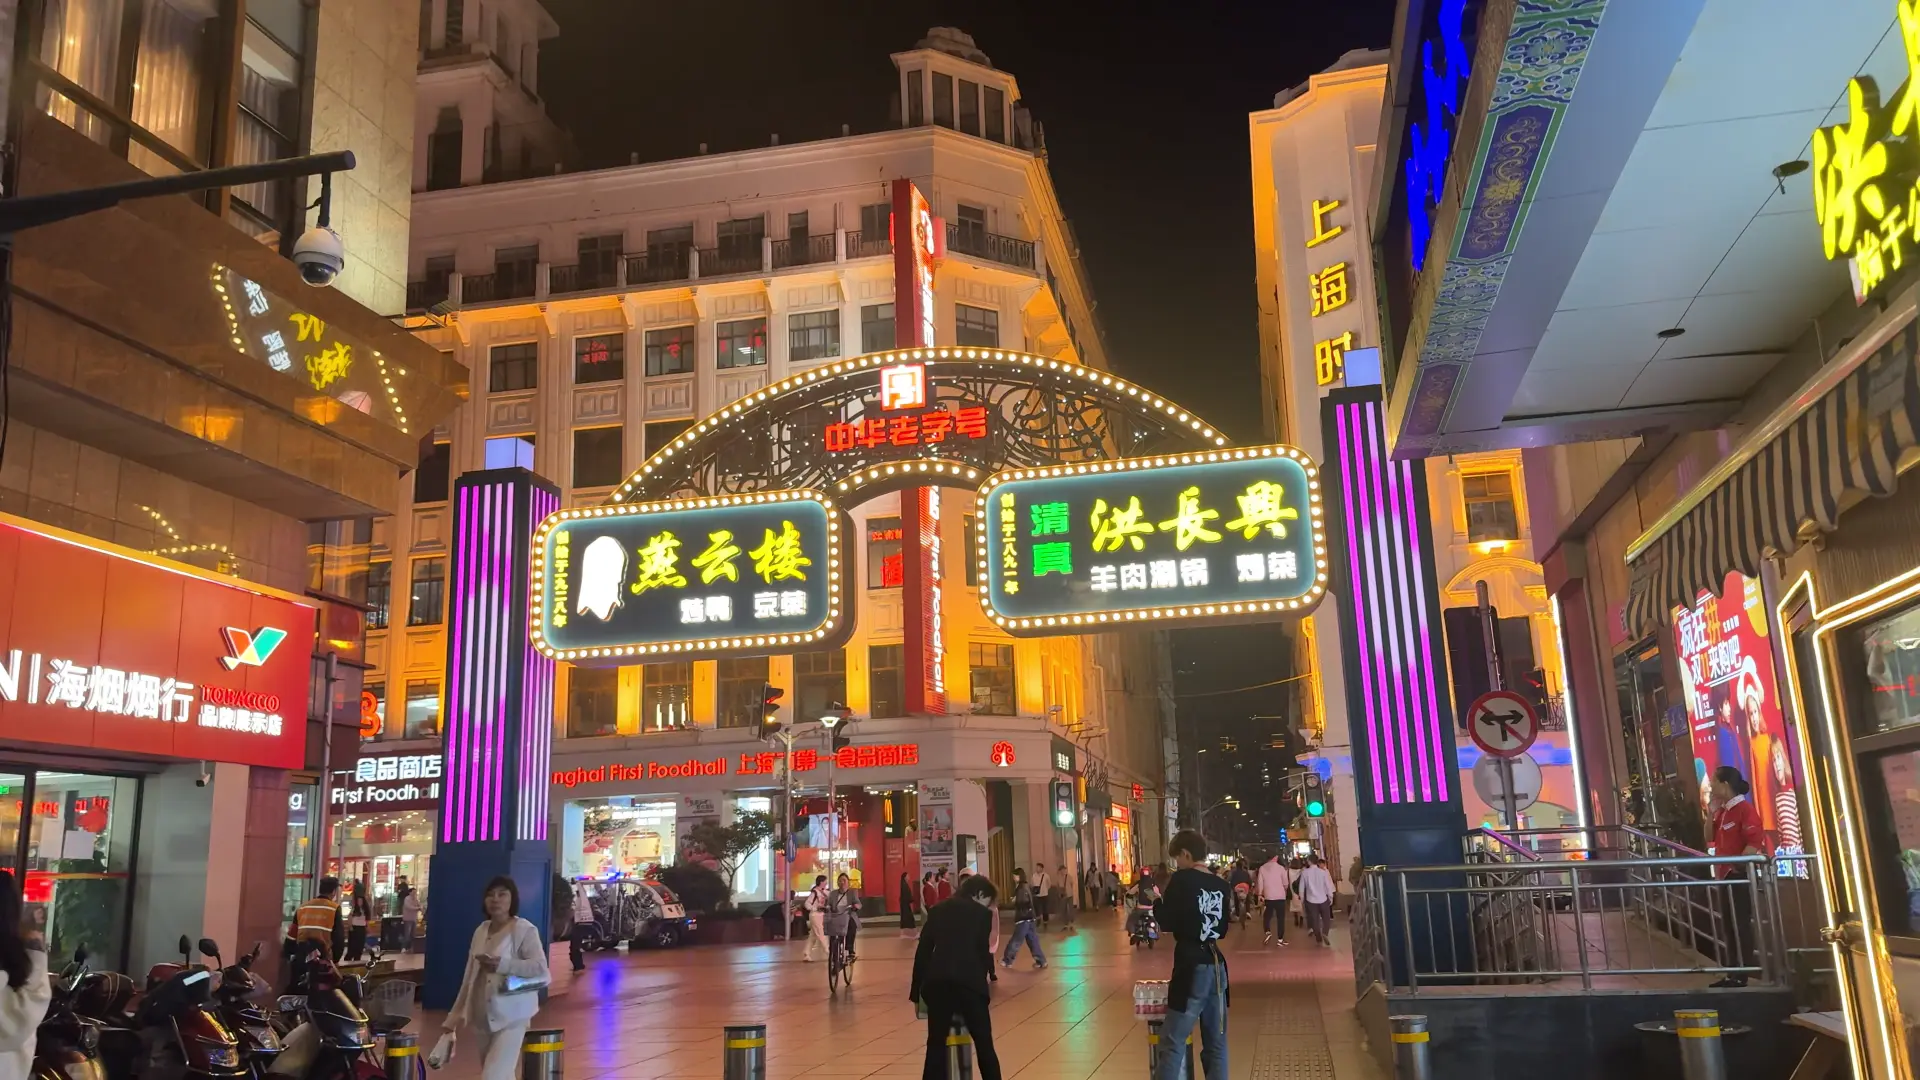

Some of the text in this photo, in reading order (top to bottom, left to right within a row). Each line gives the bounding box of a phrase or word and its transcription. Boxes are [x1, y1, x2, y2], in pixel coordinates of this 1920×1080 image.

[824, 406, 988, 452] 中华老字号
[1030, 502, 1074, 577] 清真
[1089, 480, 1299, 552] 洪長興
[631, 520, 812, 596] 燕云楼
[932, 584, 945, 693] Foodhall
[46, 658, 195, 723] 海烟烟行
[201, 684, 280, 712] TOBACCO
[198, 704, 283, 737] 品牌展示店
[366, 782, 440, 802] Foodhall
[609, 761, 643, 781] First
[648, 757, 727, 779] Foodhall
